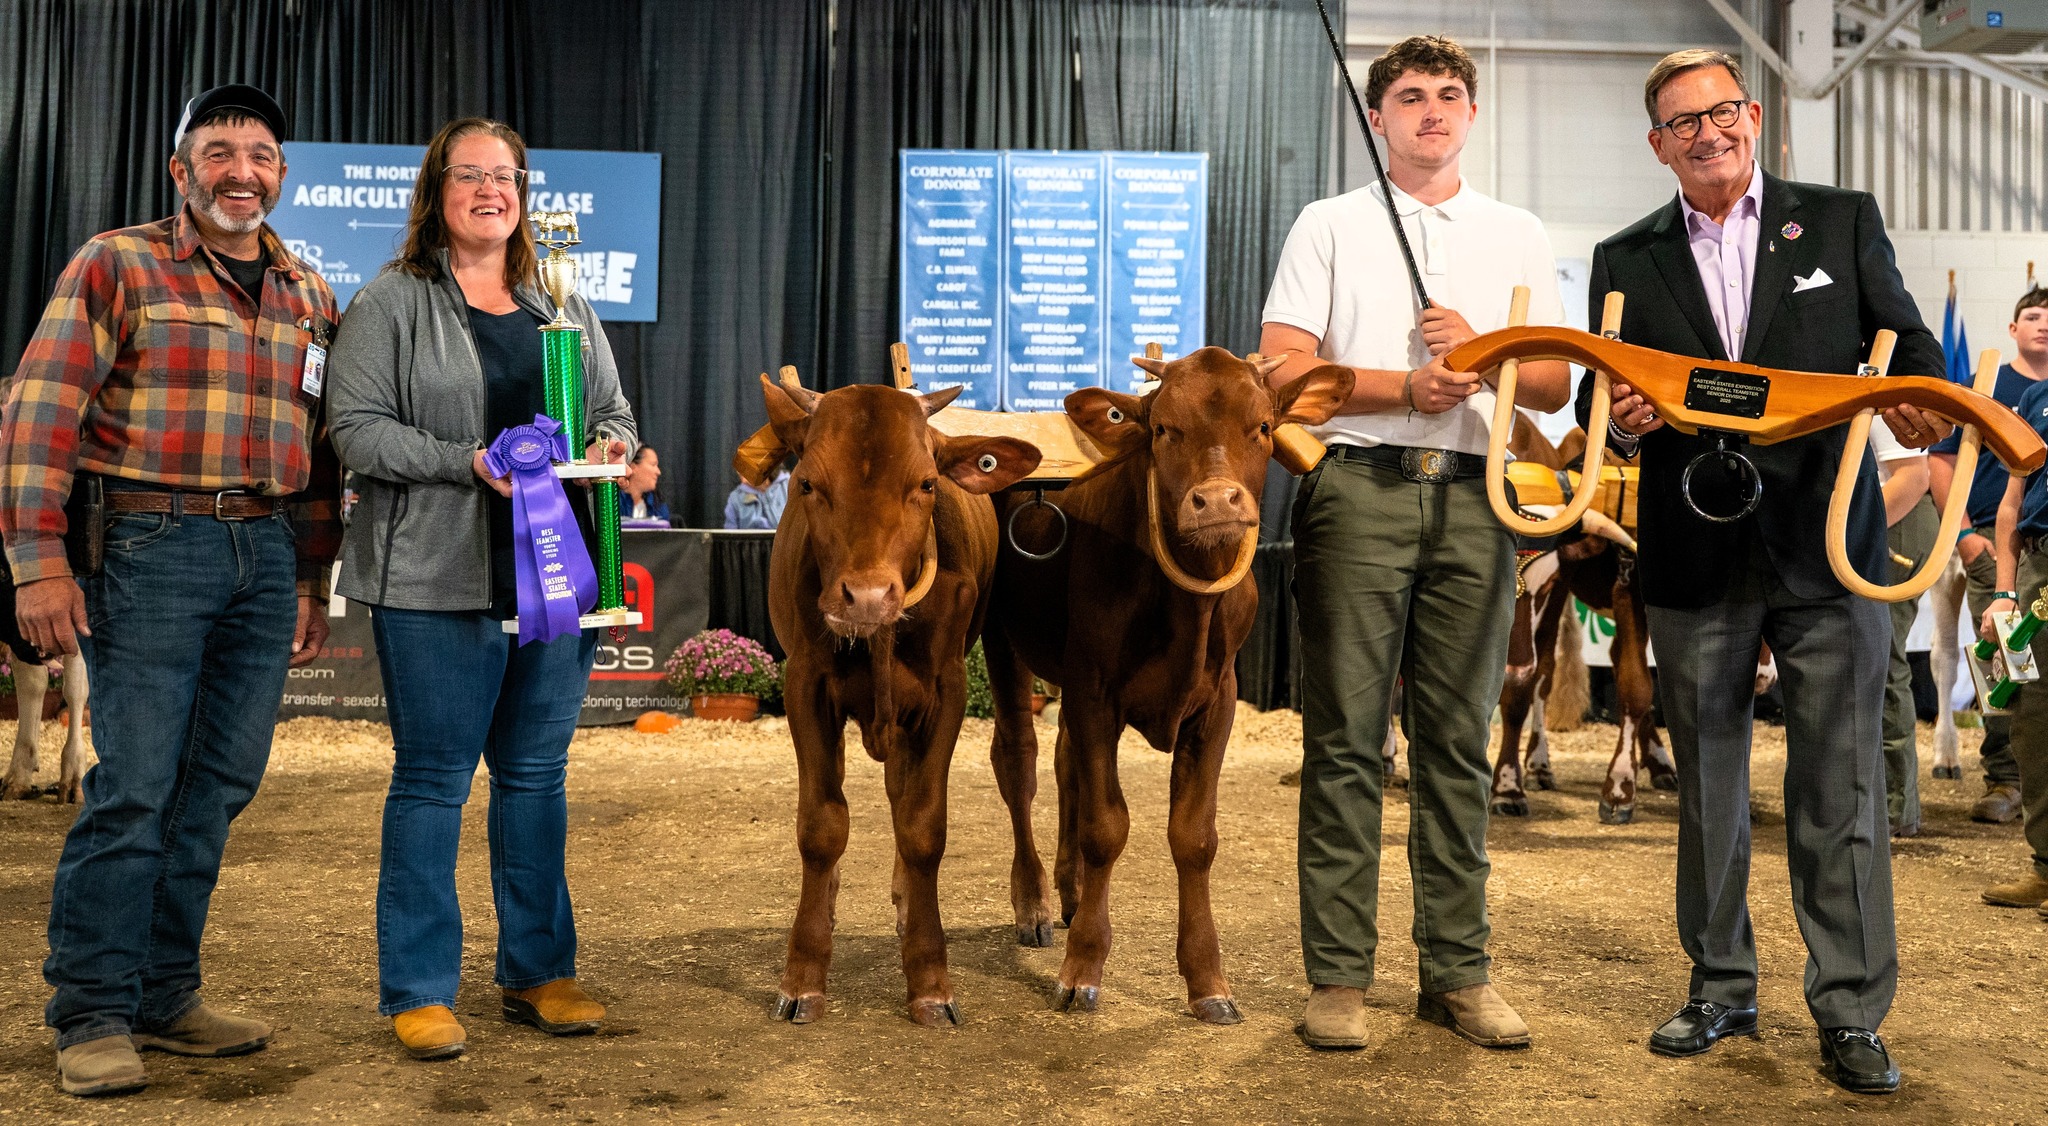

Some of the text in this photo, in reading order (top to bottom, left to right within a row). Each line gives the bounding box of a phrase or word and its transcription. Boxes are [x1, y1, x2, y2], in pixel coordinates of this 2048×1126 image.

[343, 164, 546, 185] THE NORT ER
[910, 166, 994, 178] CORPORATE
[1013, 167, 1096, 180] CORPORATE
[1115, 168, 1198, 181] CORPORATE
[924, 179, 981, 190] DONORS
[1027, 180, 1083, 191] DONORS
[1128, 181, 1185, 193] DONORS
[292, 184, 411, 209] AGRICULT
[916, 236, 966, 246] ANDERSON
[1069, 237, 1096, 247] FARM
[939, 247, 965, 257] FARM
[1022, 253, 1087, 265] NEW ENGLAND
[320, 272, 361, 284] TATES
[606, 251, 638, 304] E
[936, 283, 967, 292] CABOT
[1021, 282, 1087, 293] NEW ENGLAND
[1010, 293, 1095, 304] DAIRY PROMOTION
[922, 300, 981, 310] CARGILL INC.
[1038, 305, 1070, 316] BOARD
[911, 317, 993, 327] CEDAR LANE FARM
[1021, 323, 1087, 333] NEW ENGLAND
[916, 335, 987, 344] DAIRY FARMERS
[924, 347, 979, 356] OF AMERICA
[1023, 346, 1084, 356] ASSOCIATION
[911, 364, 993, 373] FARM CREDIT EAST
[1067, 364, 1098, 373] FARMS
[1709, 385, 1732, 394] OVERALL
[1733, 389, 1759, 397] TEAMSTER
[1735, 383, 1765, 392] EXPOSITION
[1706, 390, 1725, 398] SENIOR
[541, 528, 553, 536] BEST
[536, 535, 561, 544] TEAMSTER
[545, 576, 567, 585] EASTERN
[548, 583, 567, 592] STATES
[546, 591, 572, 600] EXPOSITION
[591, 645, 655, 670] CS
[287, 668, 335, 679] com
[283, 693, 336, 706] transfer
[342, 694, 379, 707] sexed
[582, 695, 691, 712] cloning technology
